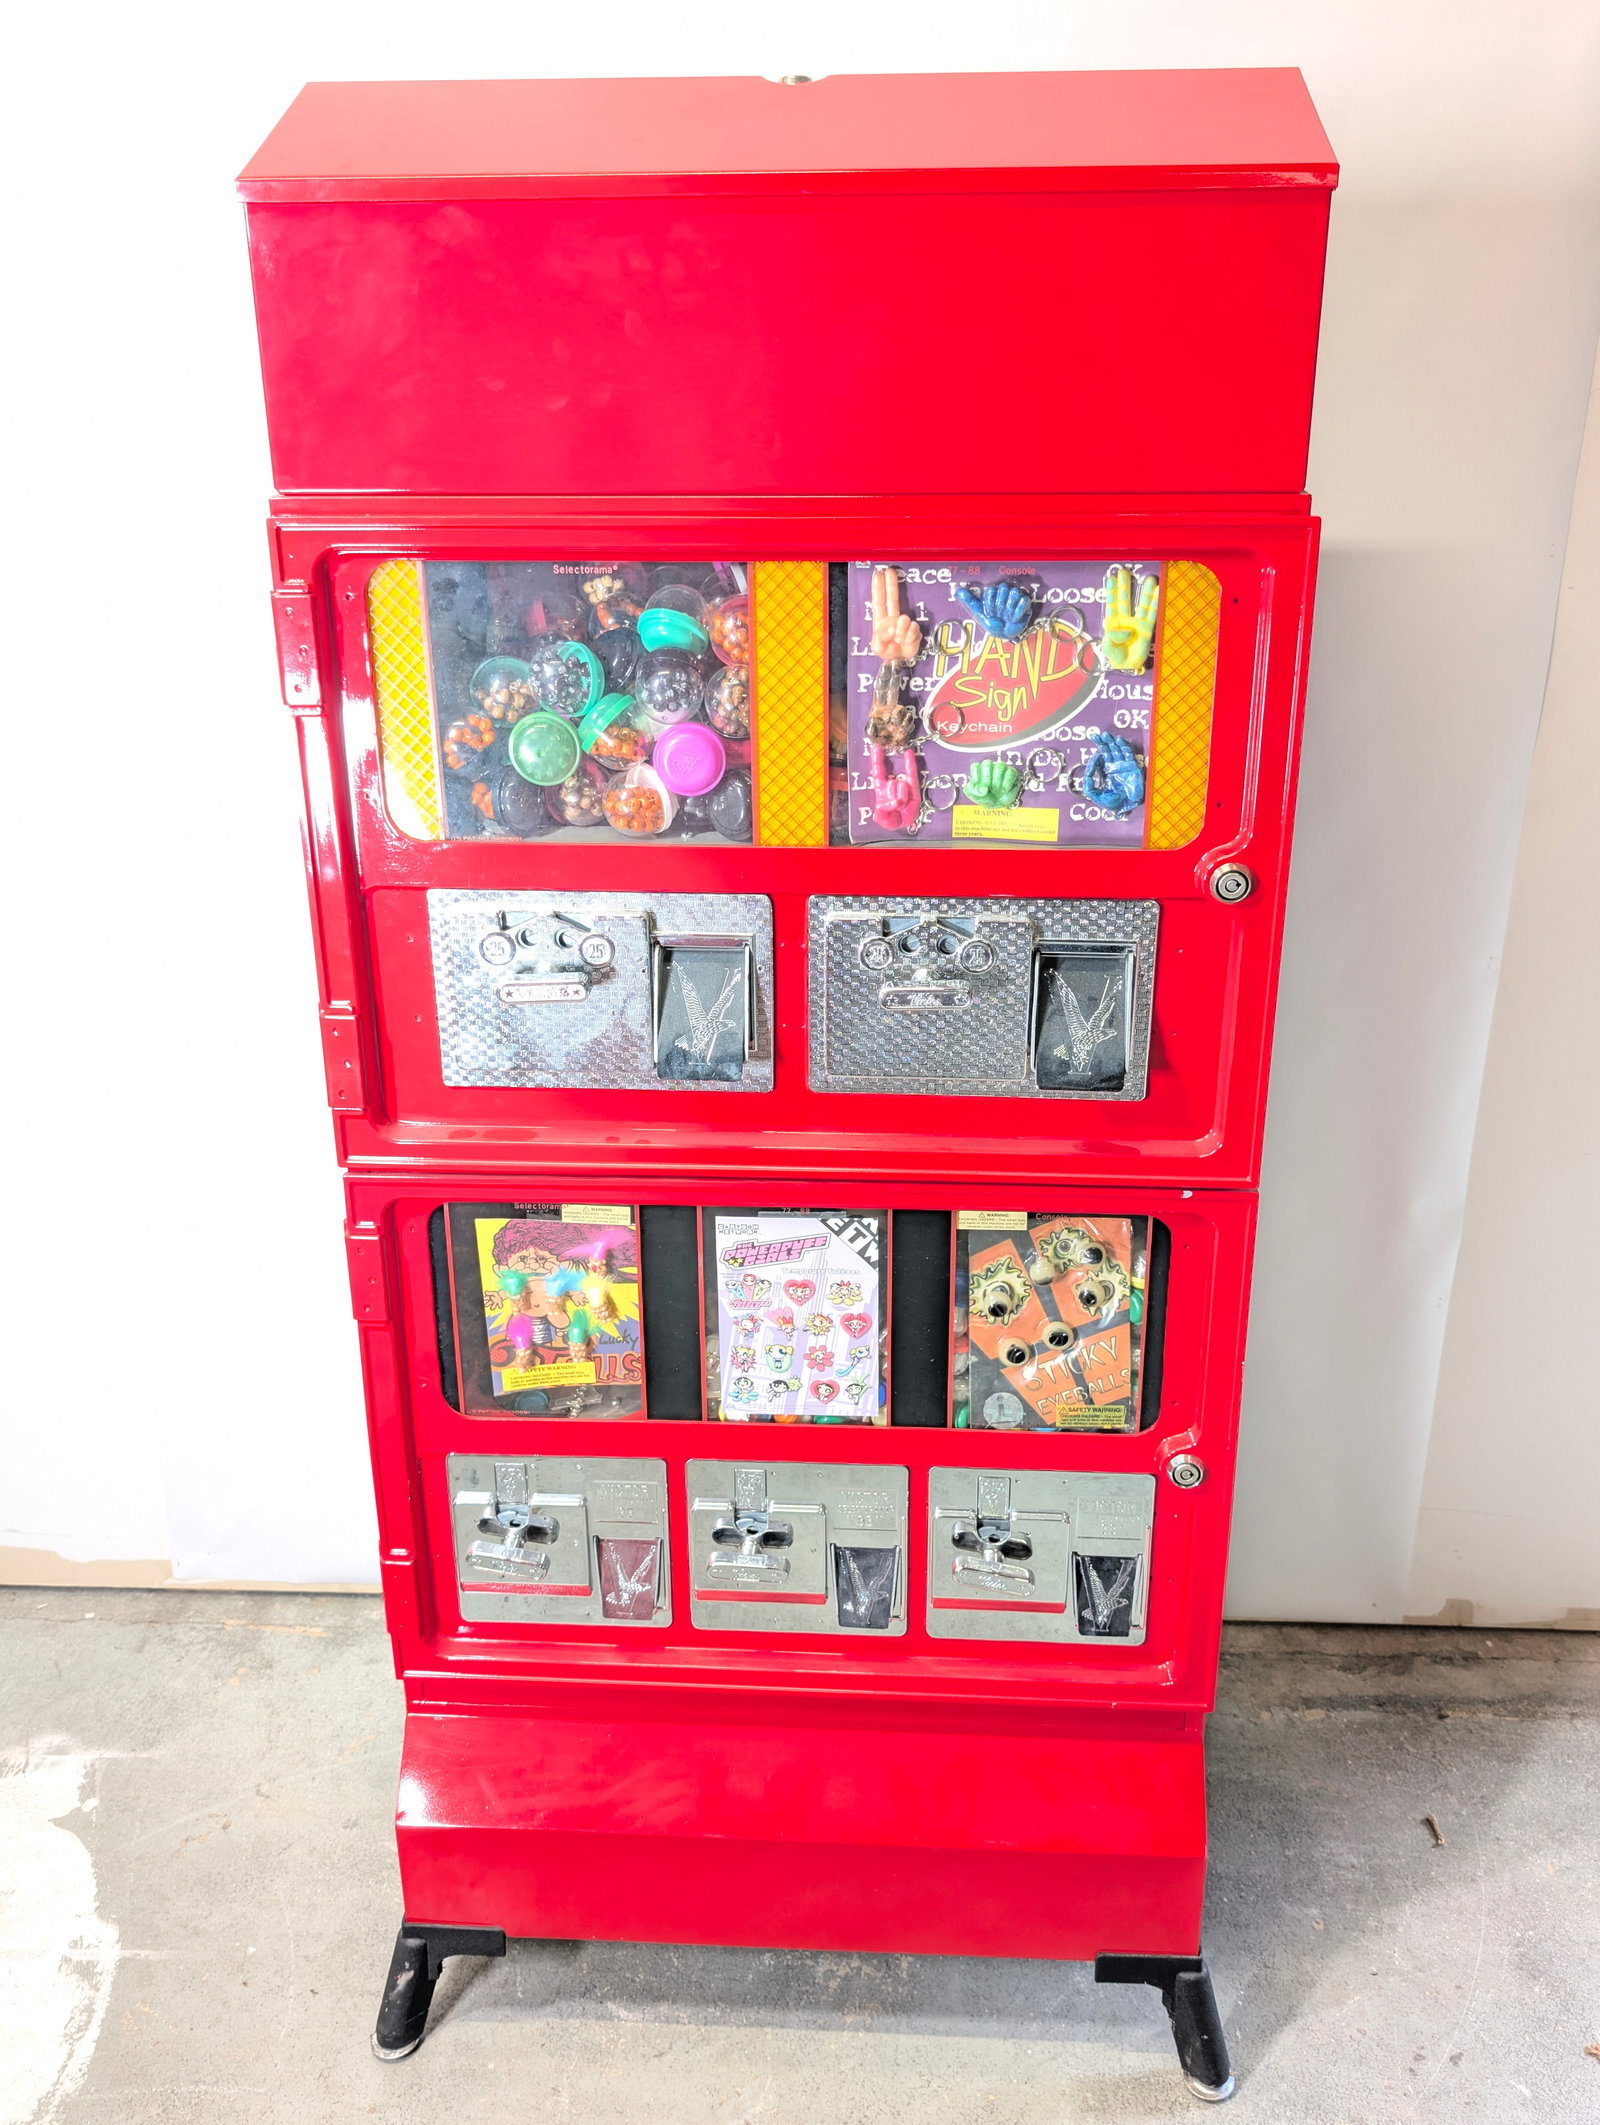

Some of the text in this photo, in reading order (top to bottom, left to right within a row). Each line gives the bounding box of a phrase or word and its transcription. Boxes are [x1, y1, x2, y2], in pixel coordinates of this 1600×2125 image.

[874, 564, 952, 584] eace
[999, 565, 1036, 575] Console
[949, 675, 1028, 722] Sign
[937, 720, 1013, 734] Keychain
[723, 1235, 828, 1261] POWERPUFF
[743, 1248, 802, 1267] GIRLS
